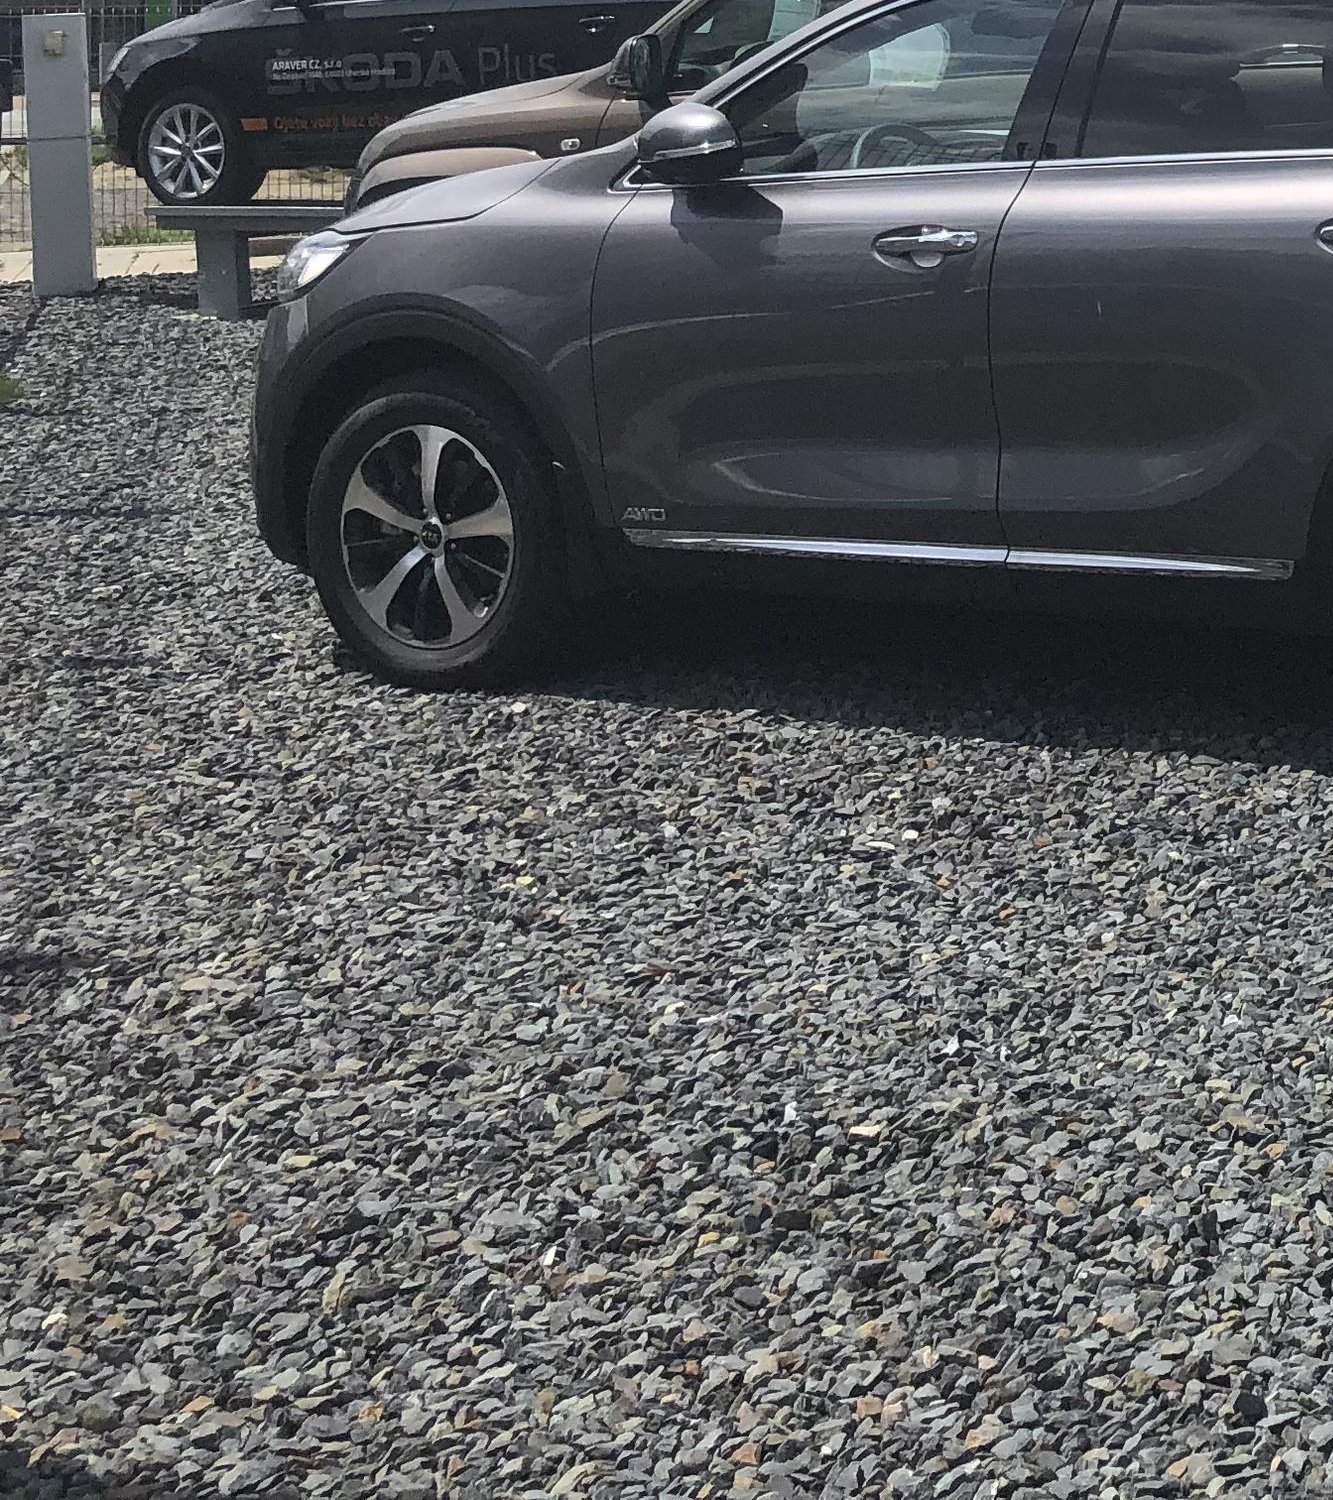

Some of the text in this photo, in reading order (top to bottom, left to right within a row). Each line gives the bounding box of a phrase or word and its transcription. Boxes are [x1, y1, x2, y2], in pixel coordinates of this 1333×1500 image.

[266, 43, 559, 95] ŠKODA Plus
[272, 60, 307, 71] ARAVER
